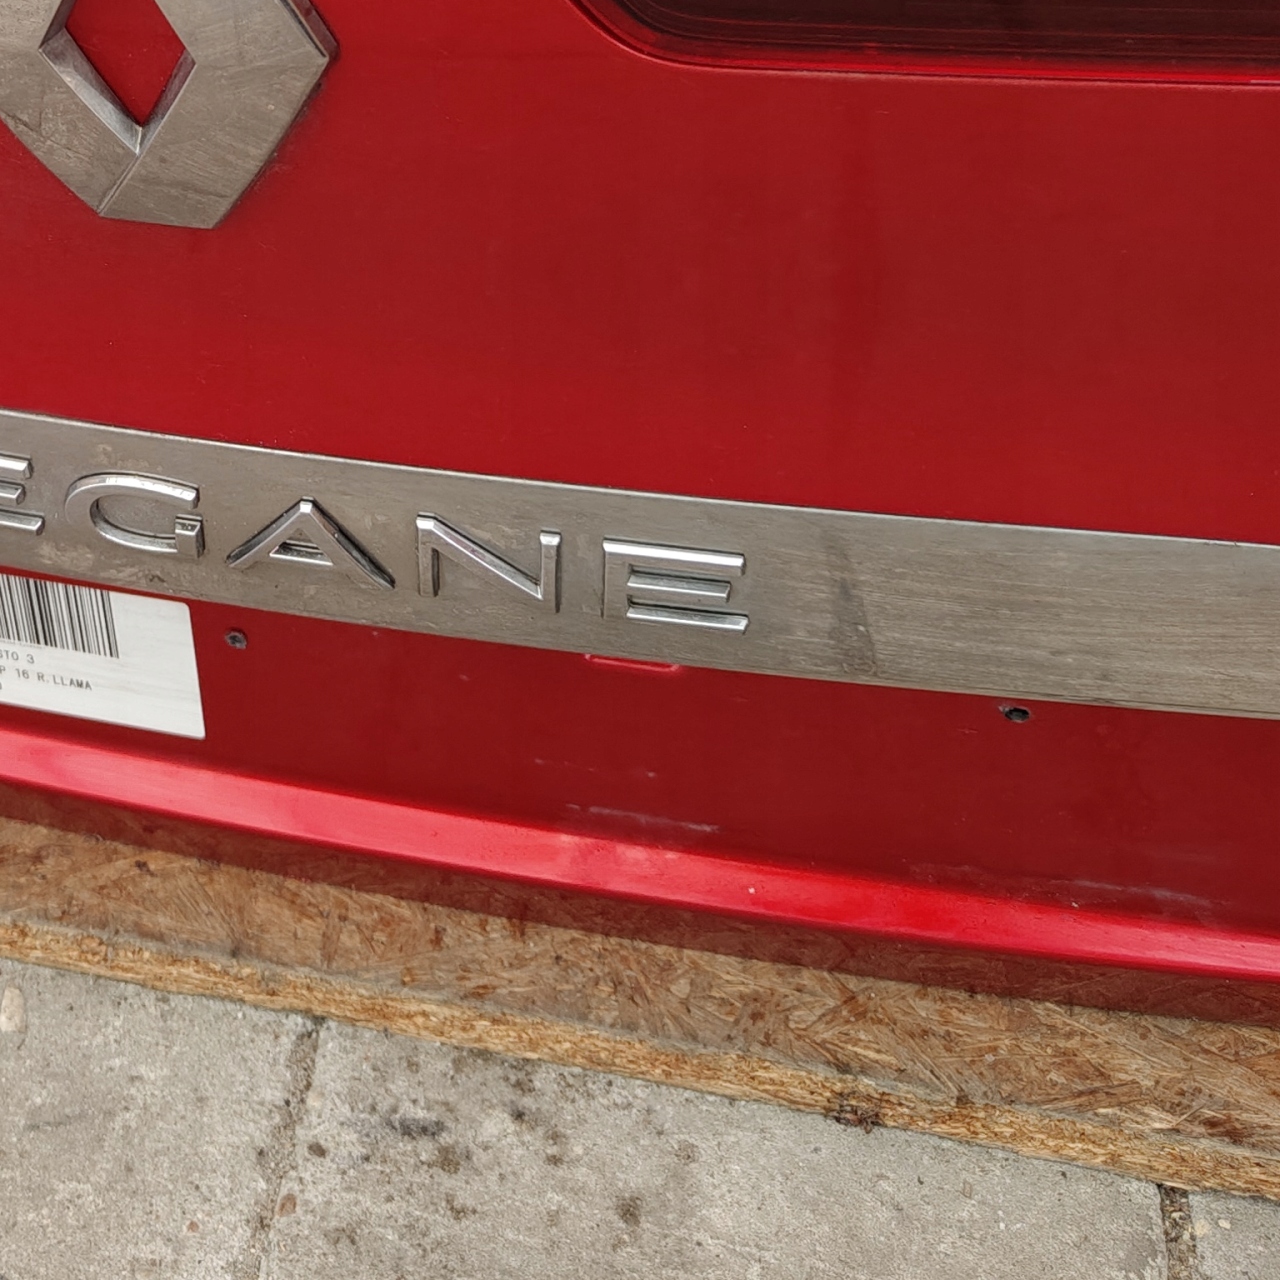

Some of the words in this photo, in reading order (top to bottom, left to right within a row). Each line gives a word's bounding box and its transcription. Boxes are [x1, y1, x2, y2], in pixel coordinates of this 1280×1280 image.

[26, 653, 35, 665] 3
[15, 667, 29, 680] 16
[37, 671, 93, 692] R.LLAMA
